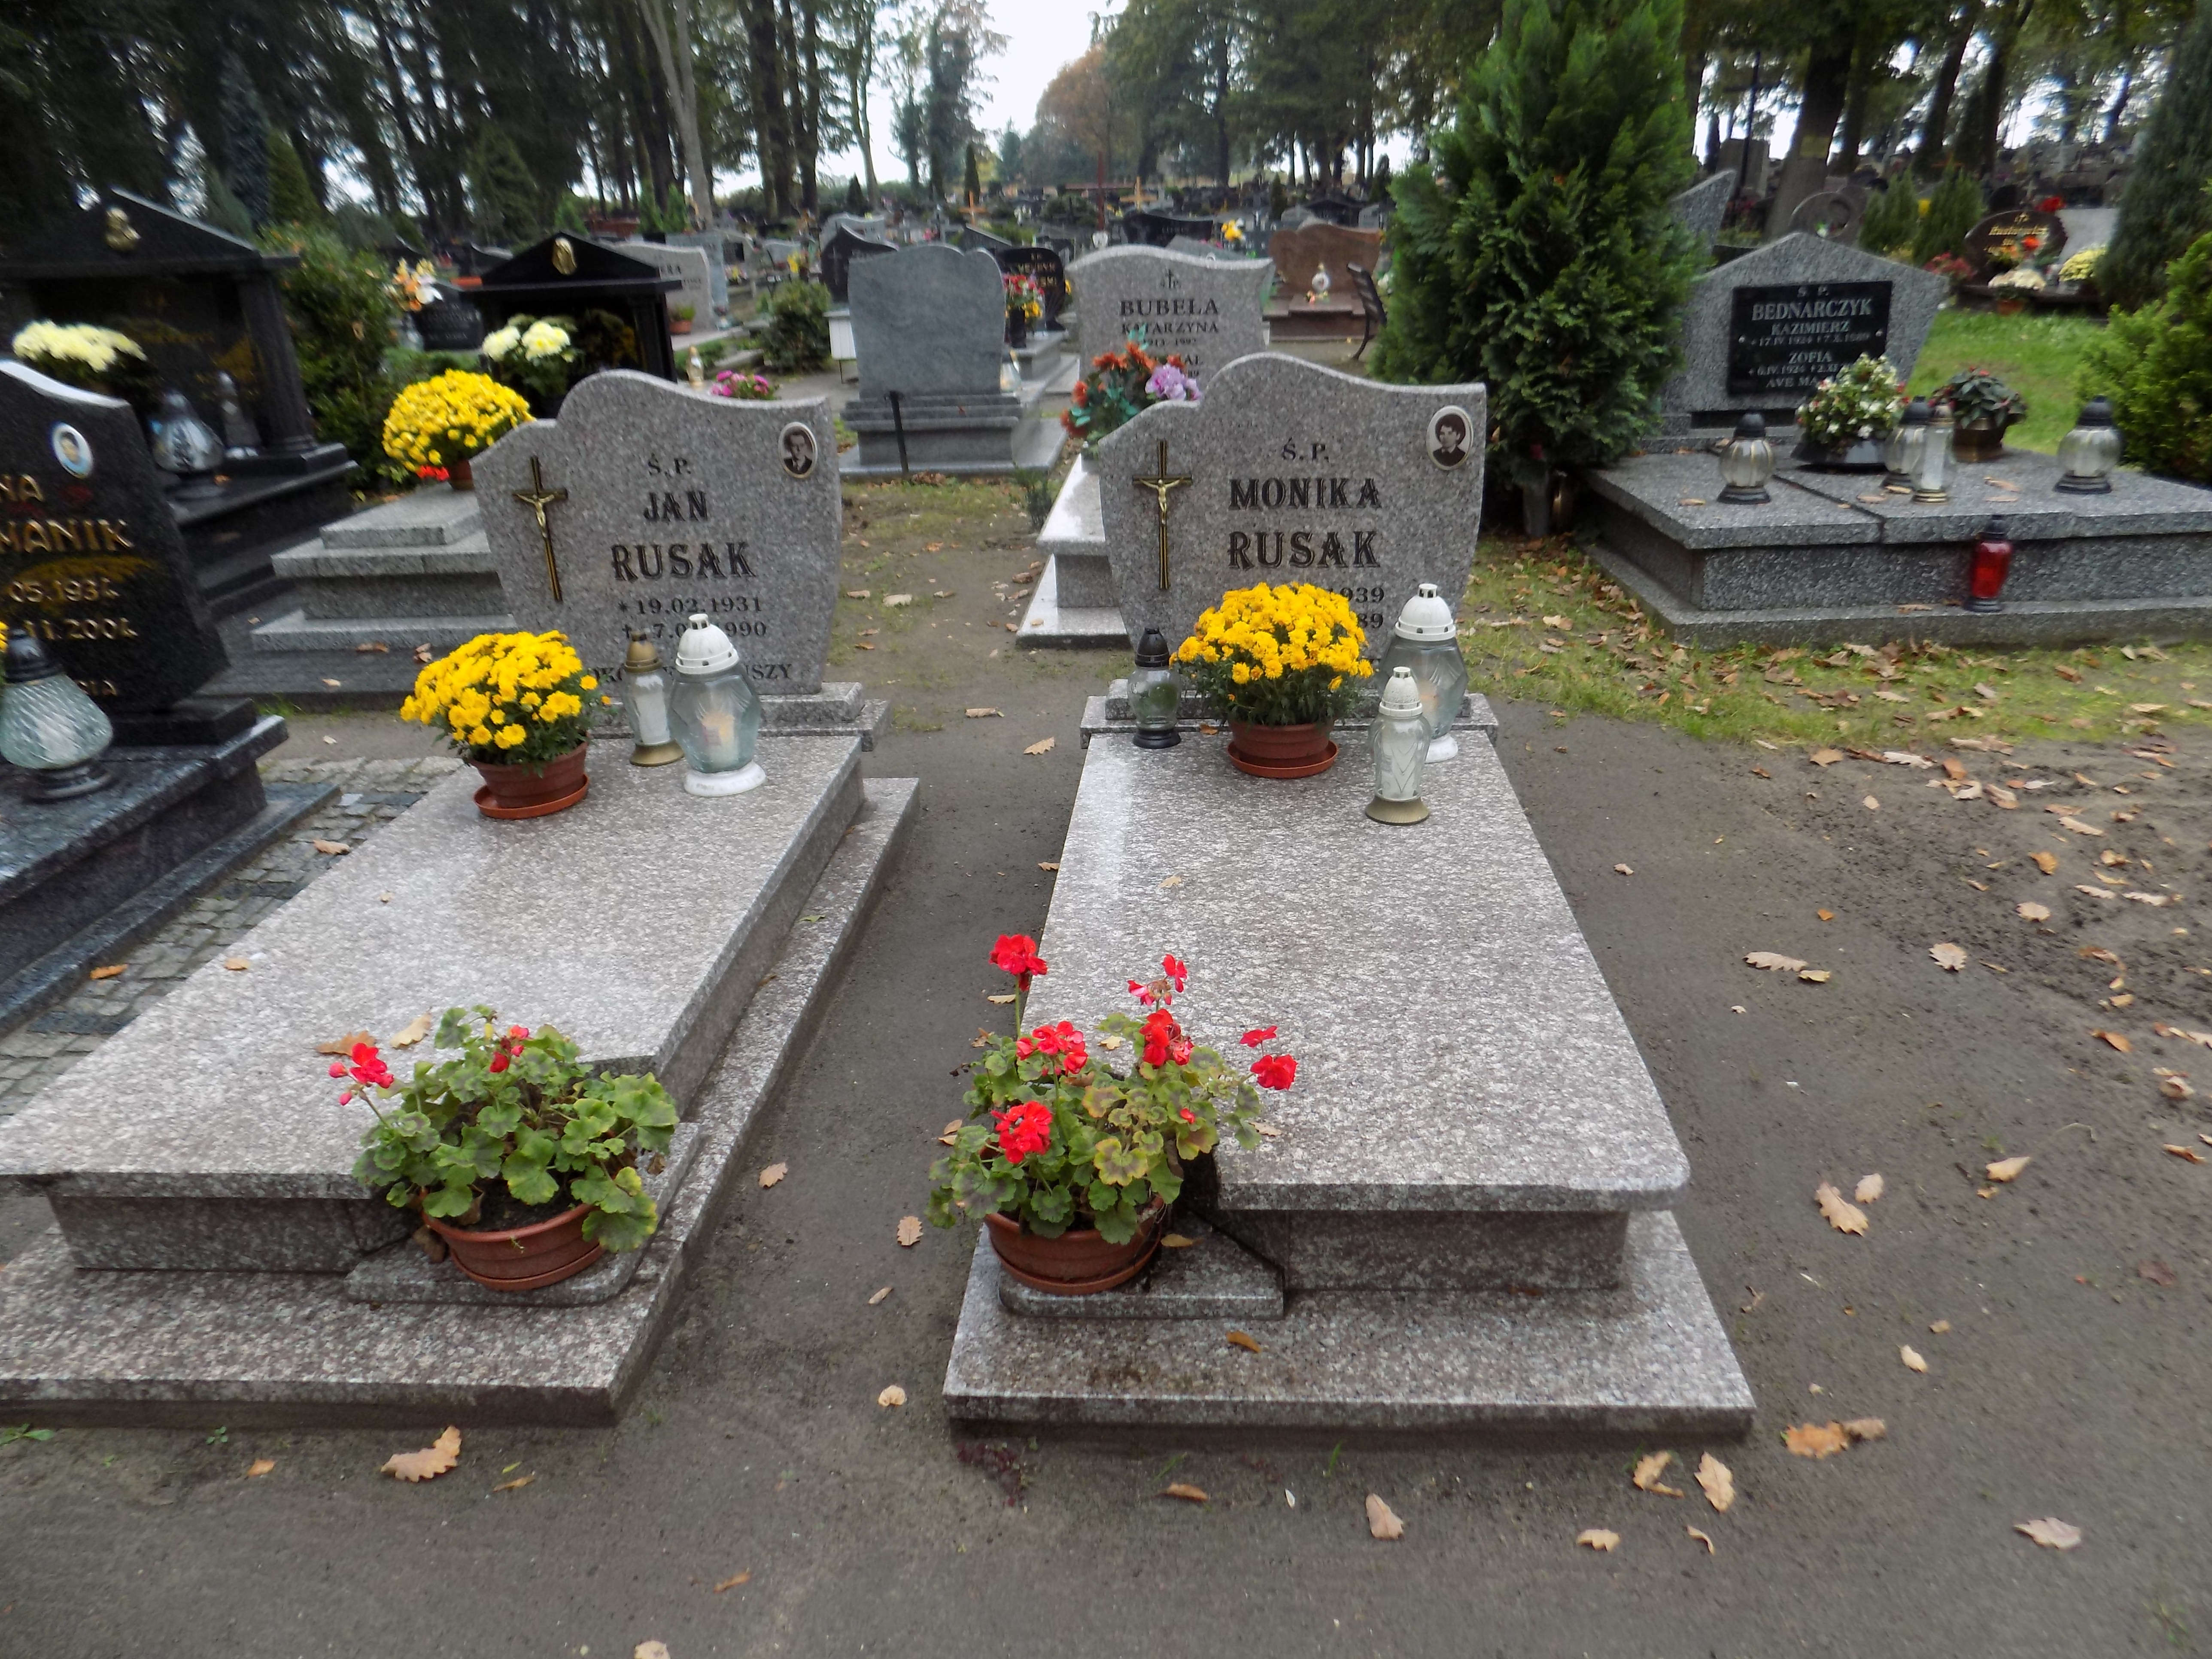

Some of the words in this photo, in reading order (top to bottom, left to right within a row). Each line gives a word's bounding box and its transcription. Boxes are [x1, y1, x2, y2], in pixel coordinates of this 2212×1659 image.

[1751, 298, 1872, 321] BEDNARCZYK
[1771, 320, 1850, 336] KAZIMIERZ
[1788, 350, 1833, 365] ZOFIA
[1282, 437, 1304, 461] Ś.
[1311, 443, 1330, 462] P.
[643, 490, 709, 524] JAN
[1228, 477, 1383, 511] MONIKA
[610, 541, 757, 583] RUSAK
[1227, 530, 1381, 571] RUSAK
